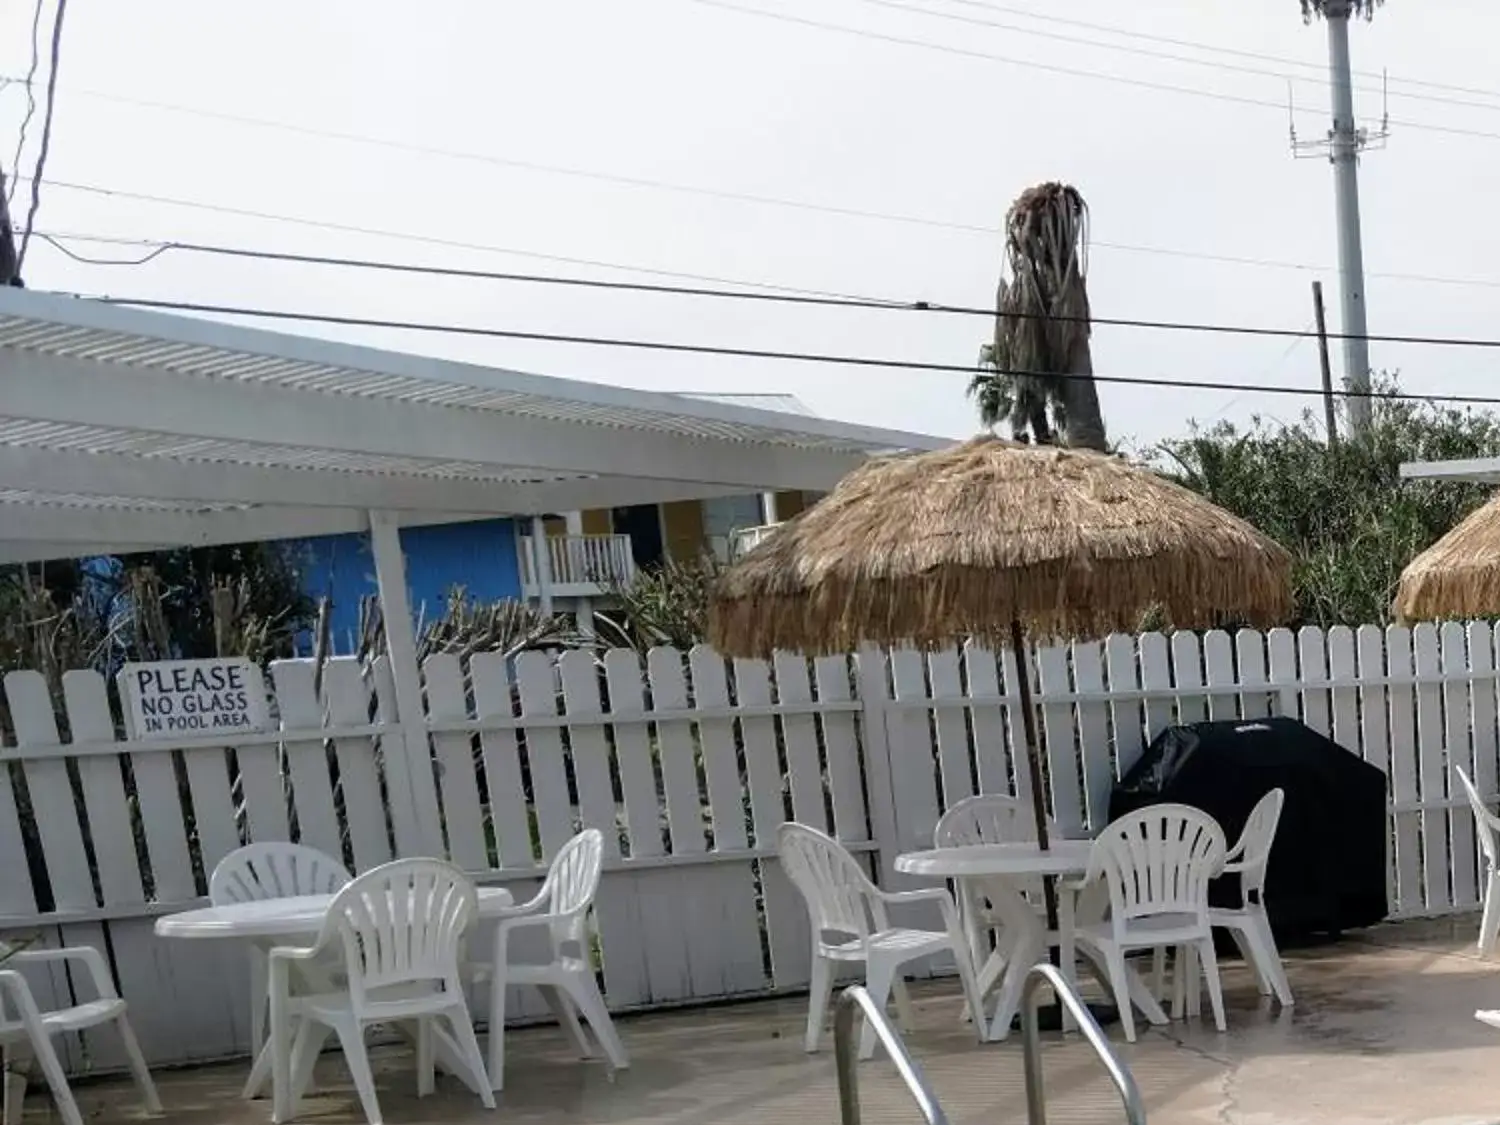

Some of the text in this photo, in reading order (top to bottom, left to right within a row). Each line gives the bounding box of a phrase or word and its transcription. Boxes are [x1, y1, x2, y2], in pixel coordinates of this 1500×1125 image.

[138, 665, 243, 694] PLEASE
[141, 692, 248, 715] NO GLASS
[145, 711, 250, 731] IN POOL AREA
